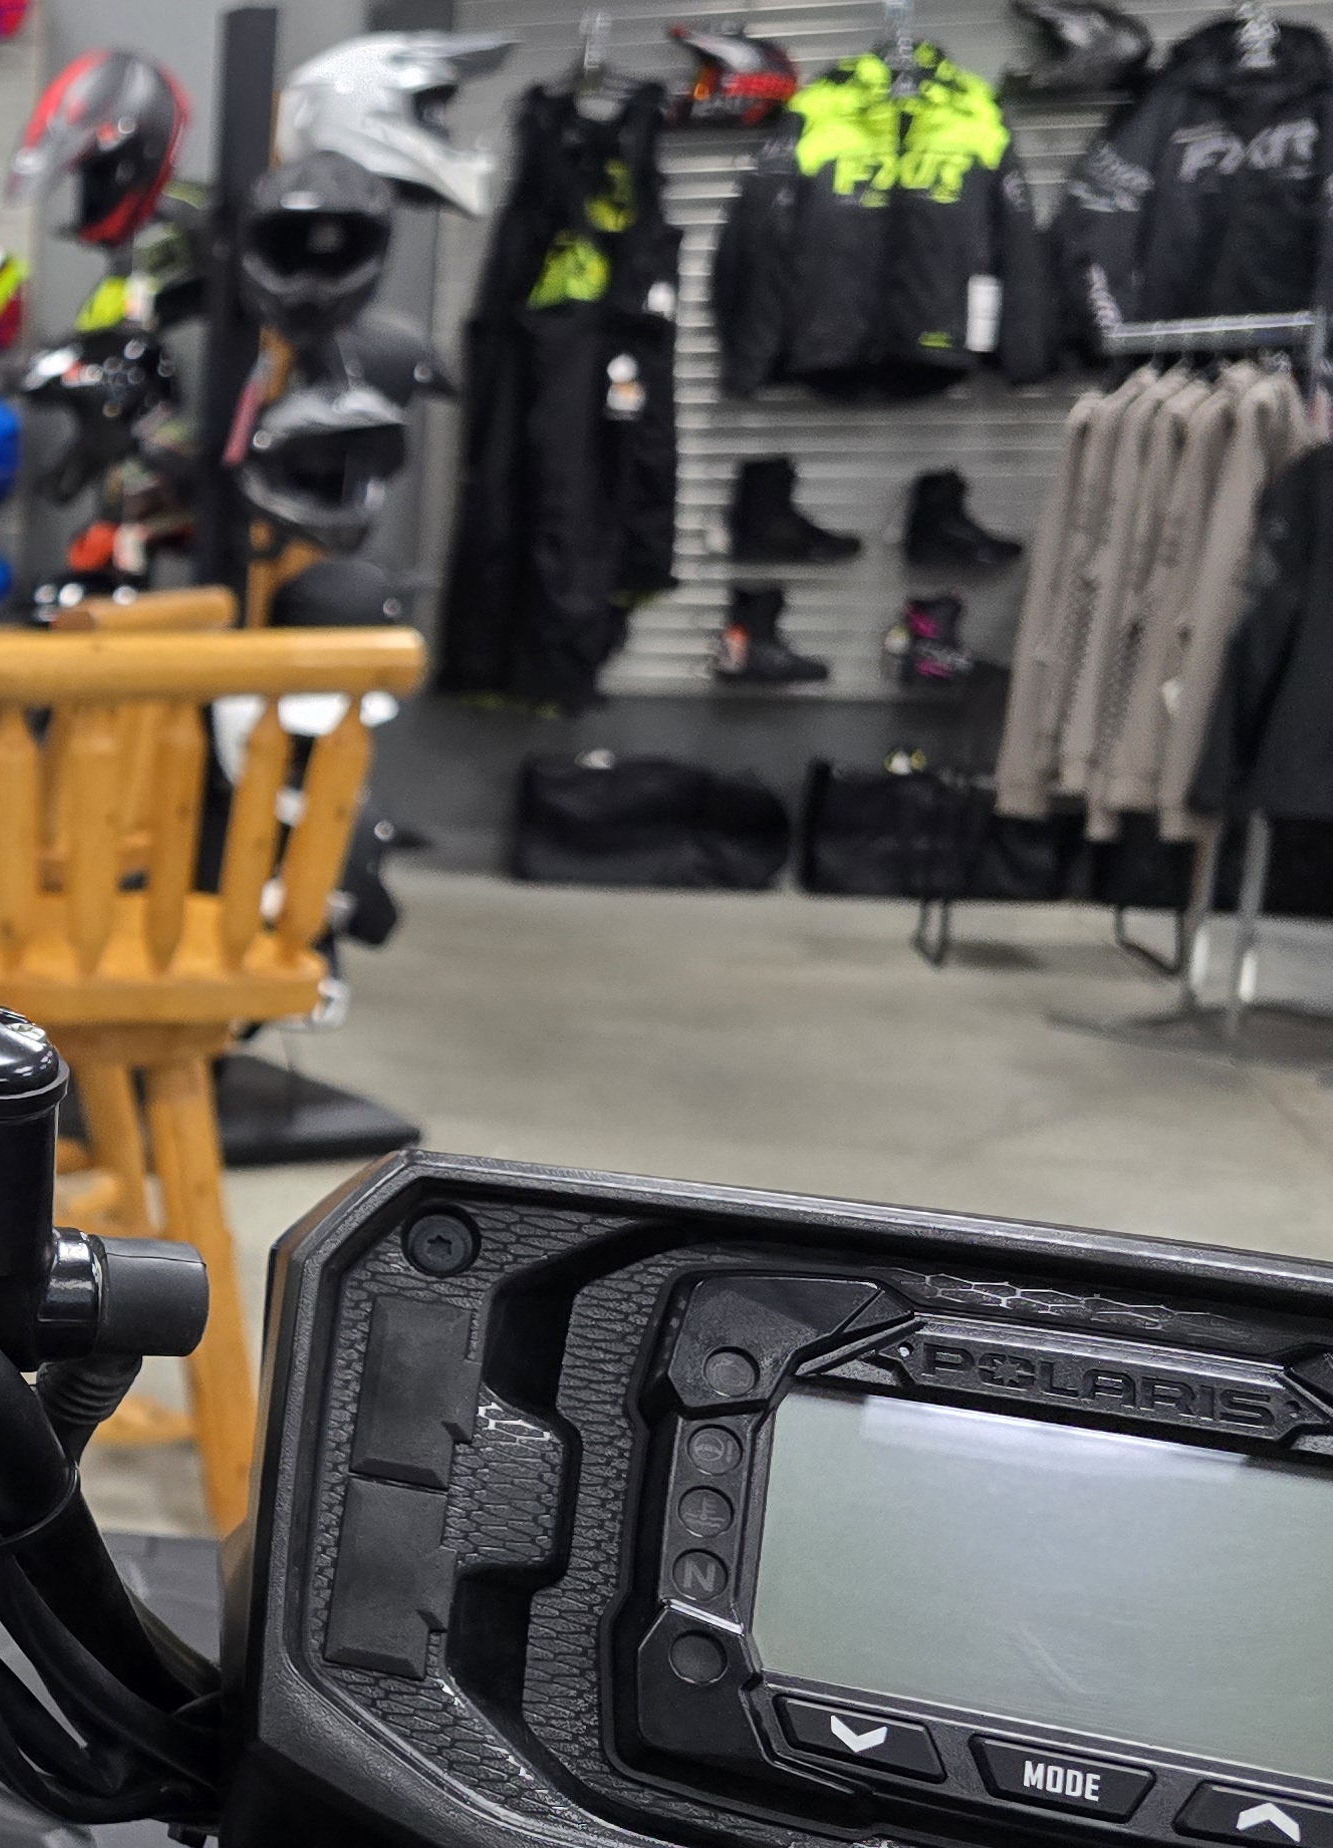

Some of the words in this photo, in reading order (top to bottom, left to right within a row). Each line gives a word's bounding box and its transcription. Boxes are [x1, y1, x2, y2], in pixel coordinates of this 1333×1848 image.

[922, 1341, 1275, 1429] POLARIS
[682, 1559, 717, 1592] N
[1022, 1760, 1101, 1802] MODE
